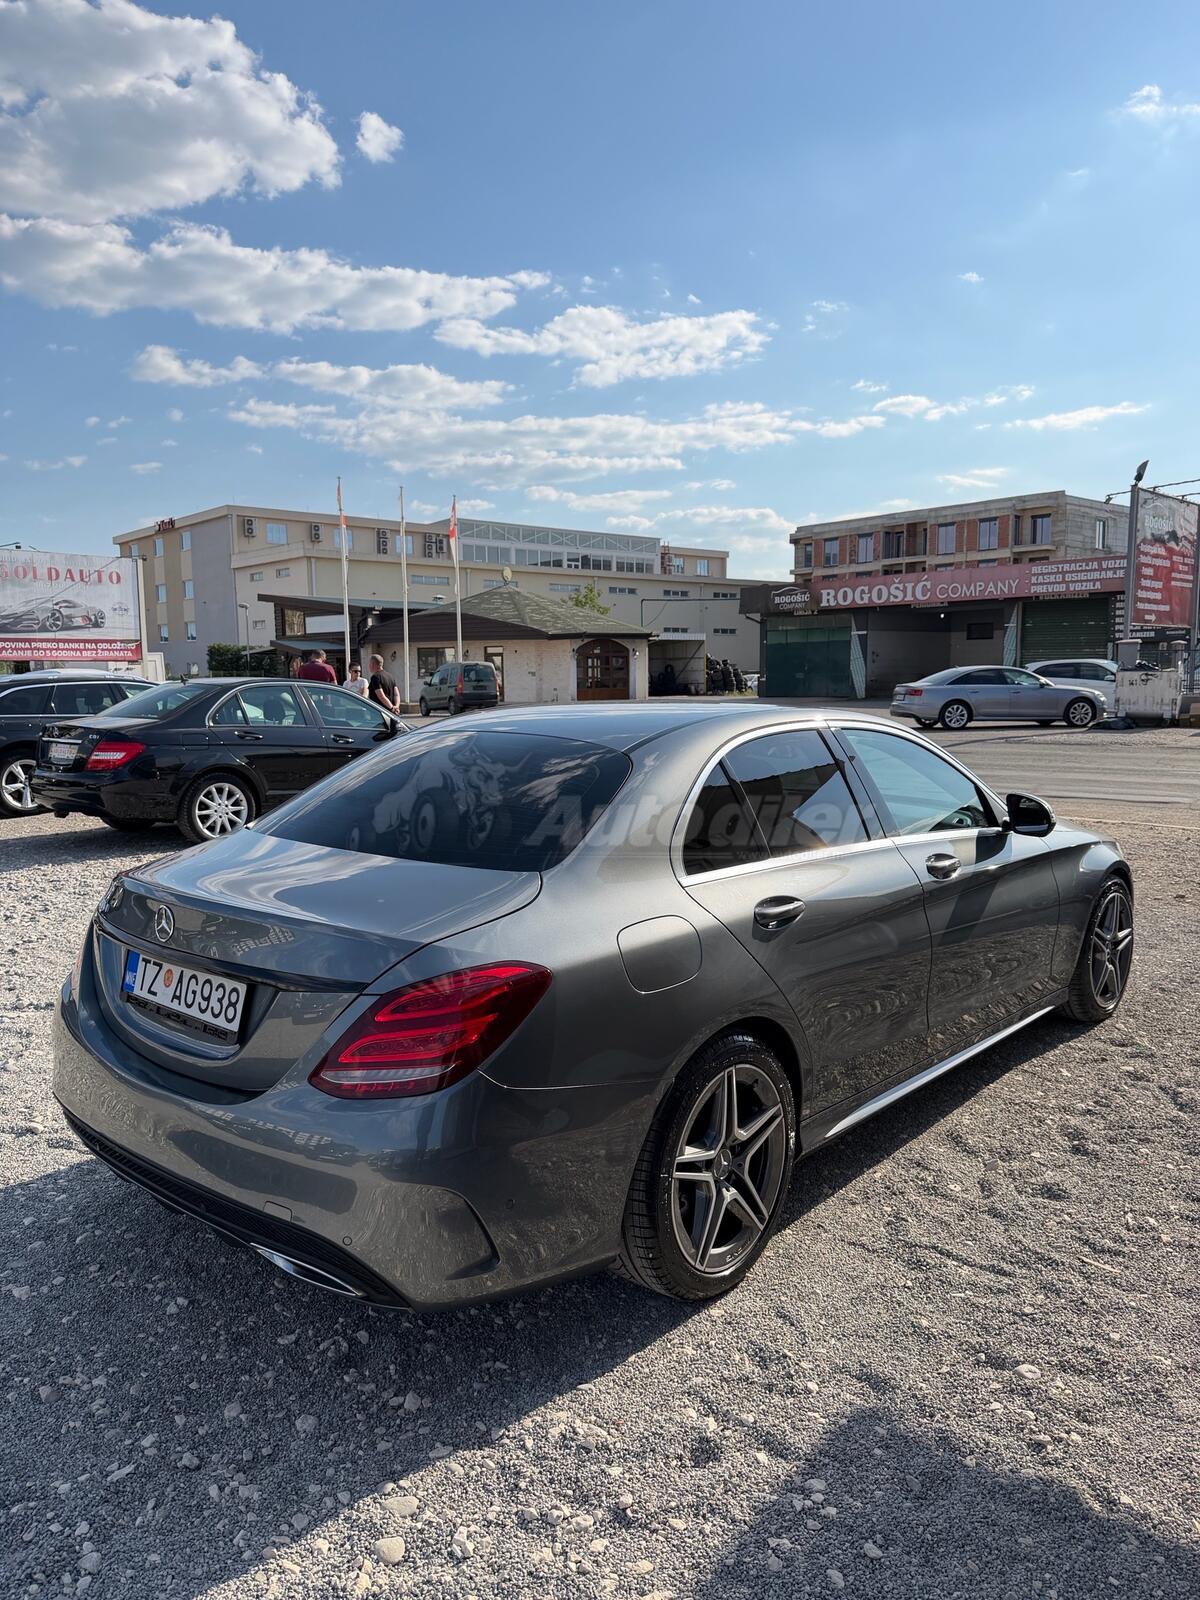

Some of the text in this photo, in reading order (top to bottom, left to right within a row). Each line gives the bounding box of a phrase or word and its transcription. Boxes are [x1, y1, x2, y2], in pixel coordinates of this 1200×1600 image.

[1031, 562, 1098, 574] REGISTRACIJA
[1031, 570, 1125, 584] KASKO OSIGURANJE
[820, 575, 1020, 607] ROGOŠIĆ COMPANY
[1030, 582, 1101, 593] PREVOD VOZILA
[774, 592, 810, 604] ROGOŠIĆ
[779, 602, 806, 610] COMPANY
[31, 641, 58, 649] PREKO
[97, 649, 133, 657] ŽIRANATA
[140, 957, 163, 997] TZ
[171, 969, 240, 1024] AG938
